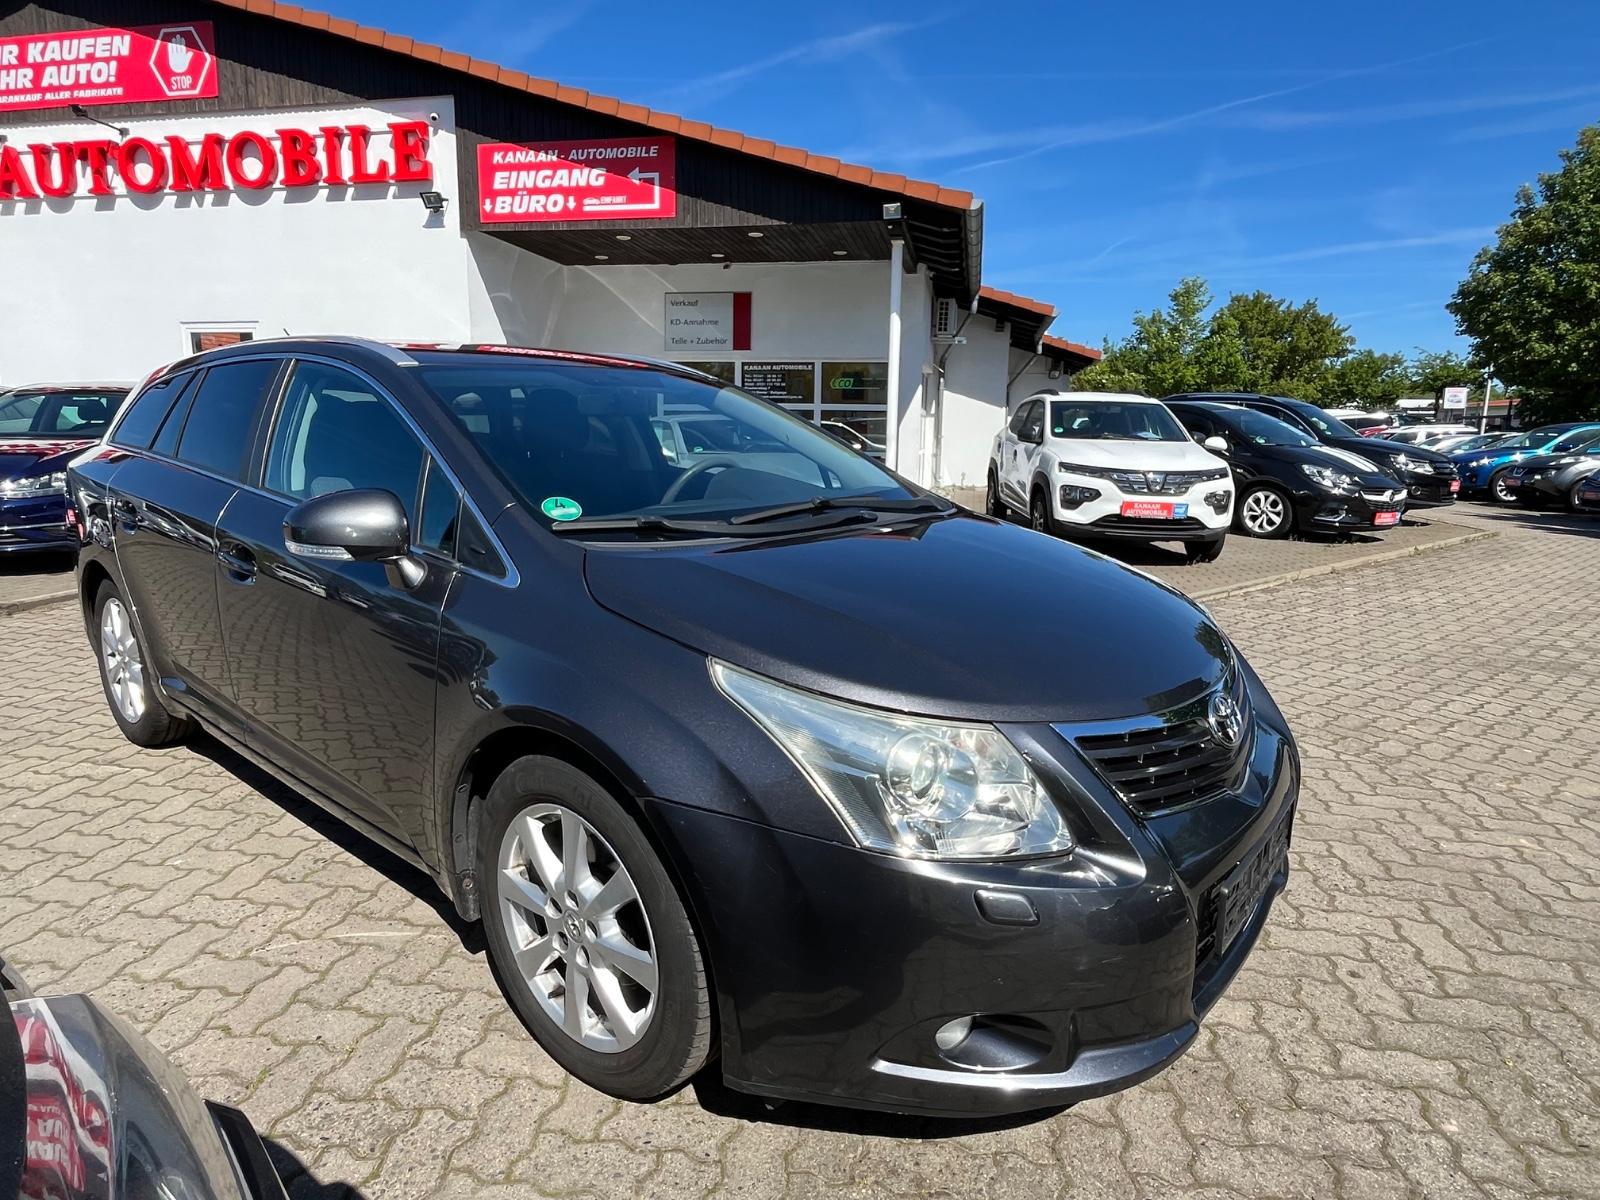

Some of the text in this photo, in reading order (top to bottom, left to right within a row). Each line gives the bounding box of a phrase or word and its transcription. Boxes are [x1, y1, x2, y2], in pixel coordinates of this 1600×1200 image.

[0, 35, 130, 65] R KAUFEN
[41, 60, 117, 88] AUTO!
[171, 75, 192, 90] STOP
[44, 90, 71, 100] ALLER
[73, 87, 123, 99] FABRIKATE
[0, 121, 433, 199] AUTOMOBILE
[493, 150, 558, 164] KANAAN
[569, 146, 659, 160] AUTOMOBILE
[493, 168, 607, 189] EINGANG
[494, 191, 565, 214] BÜRO
[670, 299, 699, 307] Verkauf
[670, 318, 719, 326] KD-Annahme
[671, 337, 688, 345] Teile
[554, 498, 566, 508] 4
[1126, 508, 1168, 516] AUTOMOBILE
